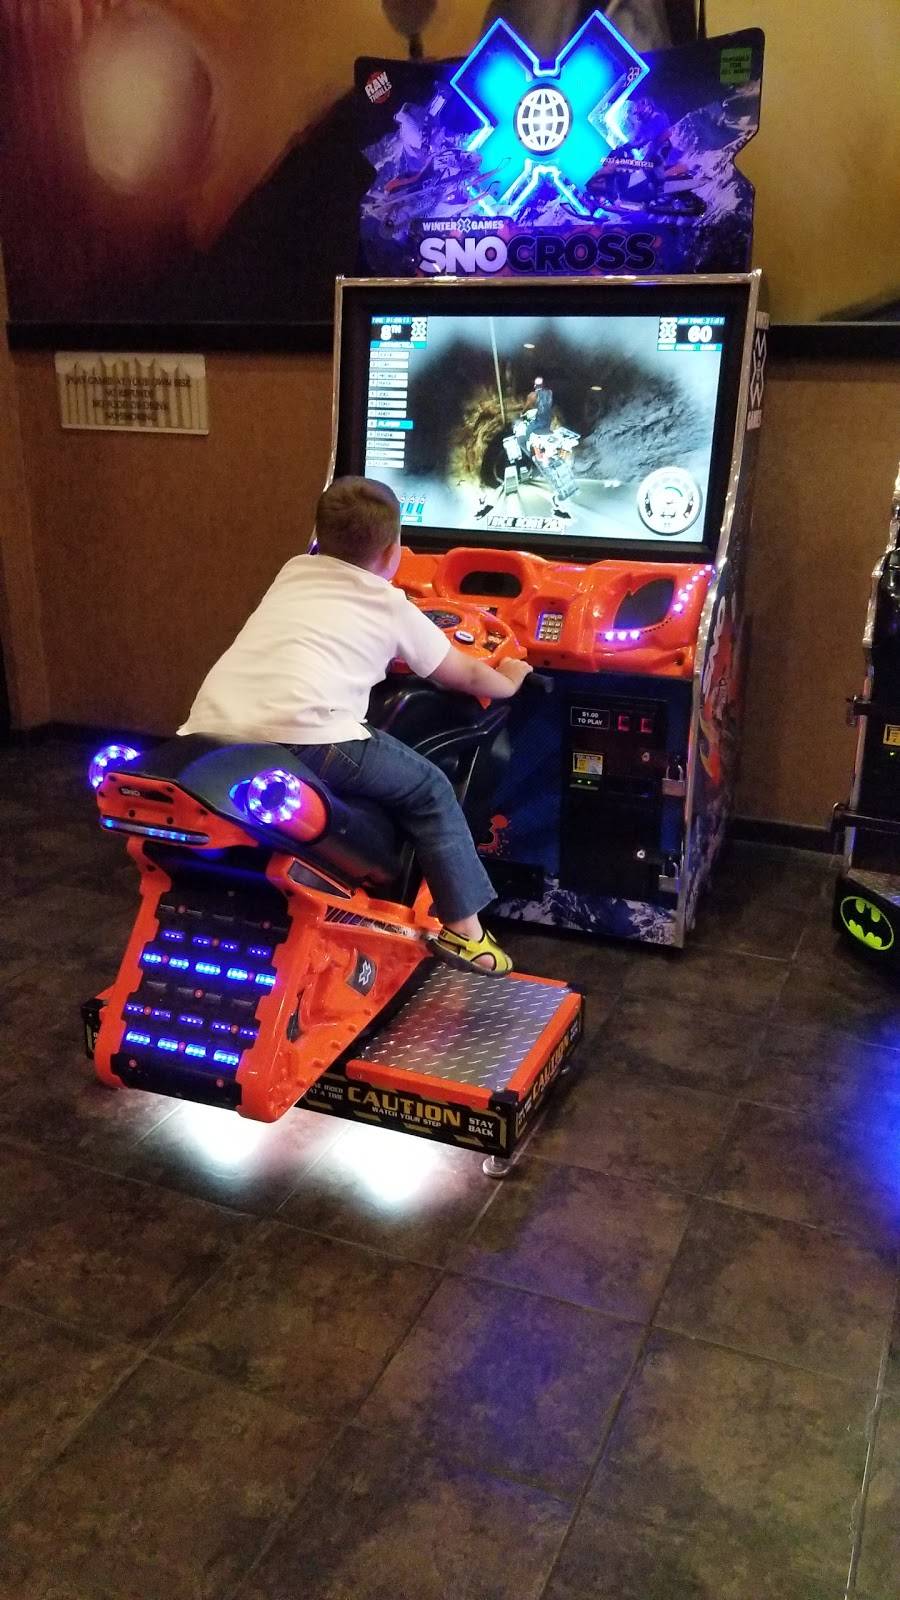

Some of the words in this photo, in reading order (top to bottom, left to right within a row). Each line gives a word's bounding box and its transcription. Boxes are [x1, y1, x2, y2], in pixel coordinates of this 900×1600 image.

[365, 71, 388, 97] RAW
[370, 81, 392, 103] THRILLS
[422, 221, 457, 232] WINTER
[471, 220, 504, 231] GAMES
[687, 325, 713, 343] 60
[587, 718, 603, 726] PLAY
[328, 1092, 343, 1101] TIME
[347, 1086, 461, 1127] CAUTION
[371, 1106, 398, 1118] WATCH
[400, 1112, 421, 1124] YOUR
[422, 1118, 442, 1128] STEP
[468, 1117, 494, 1129] STAY
[468, 1125, 494, 1137] BACK
